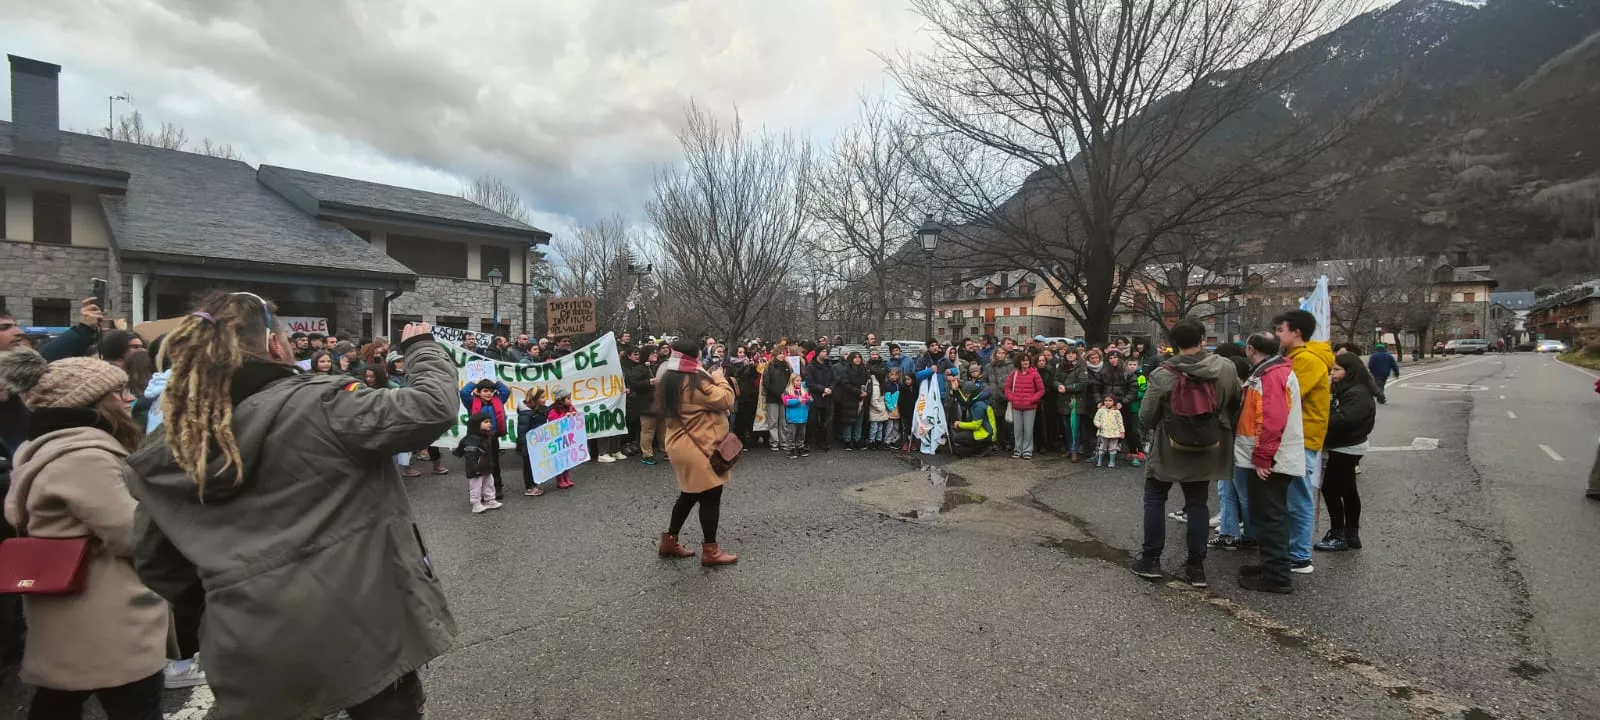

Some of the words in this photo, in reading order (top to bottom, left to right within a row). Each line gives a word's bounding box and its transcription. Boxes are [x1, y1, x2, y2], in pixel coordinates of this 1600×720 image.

[288, 320, 326, 332] VALLE
[550, 326, 562, 334] DEL
[563, 324, 585, 332] VALLE
[552, 315, 592, 326] INSTITUTO
[574, 342, 608, 370] DE
[572, 377, 598, 402] ES
[600, 374, 624, 398] UN
[528, 412, 584, 447] QUEREMOS
[541, 432, 576, 457] ESTAR
